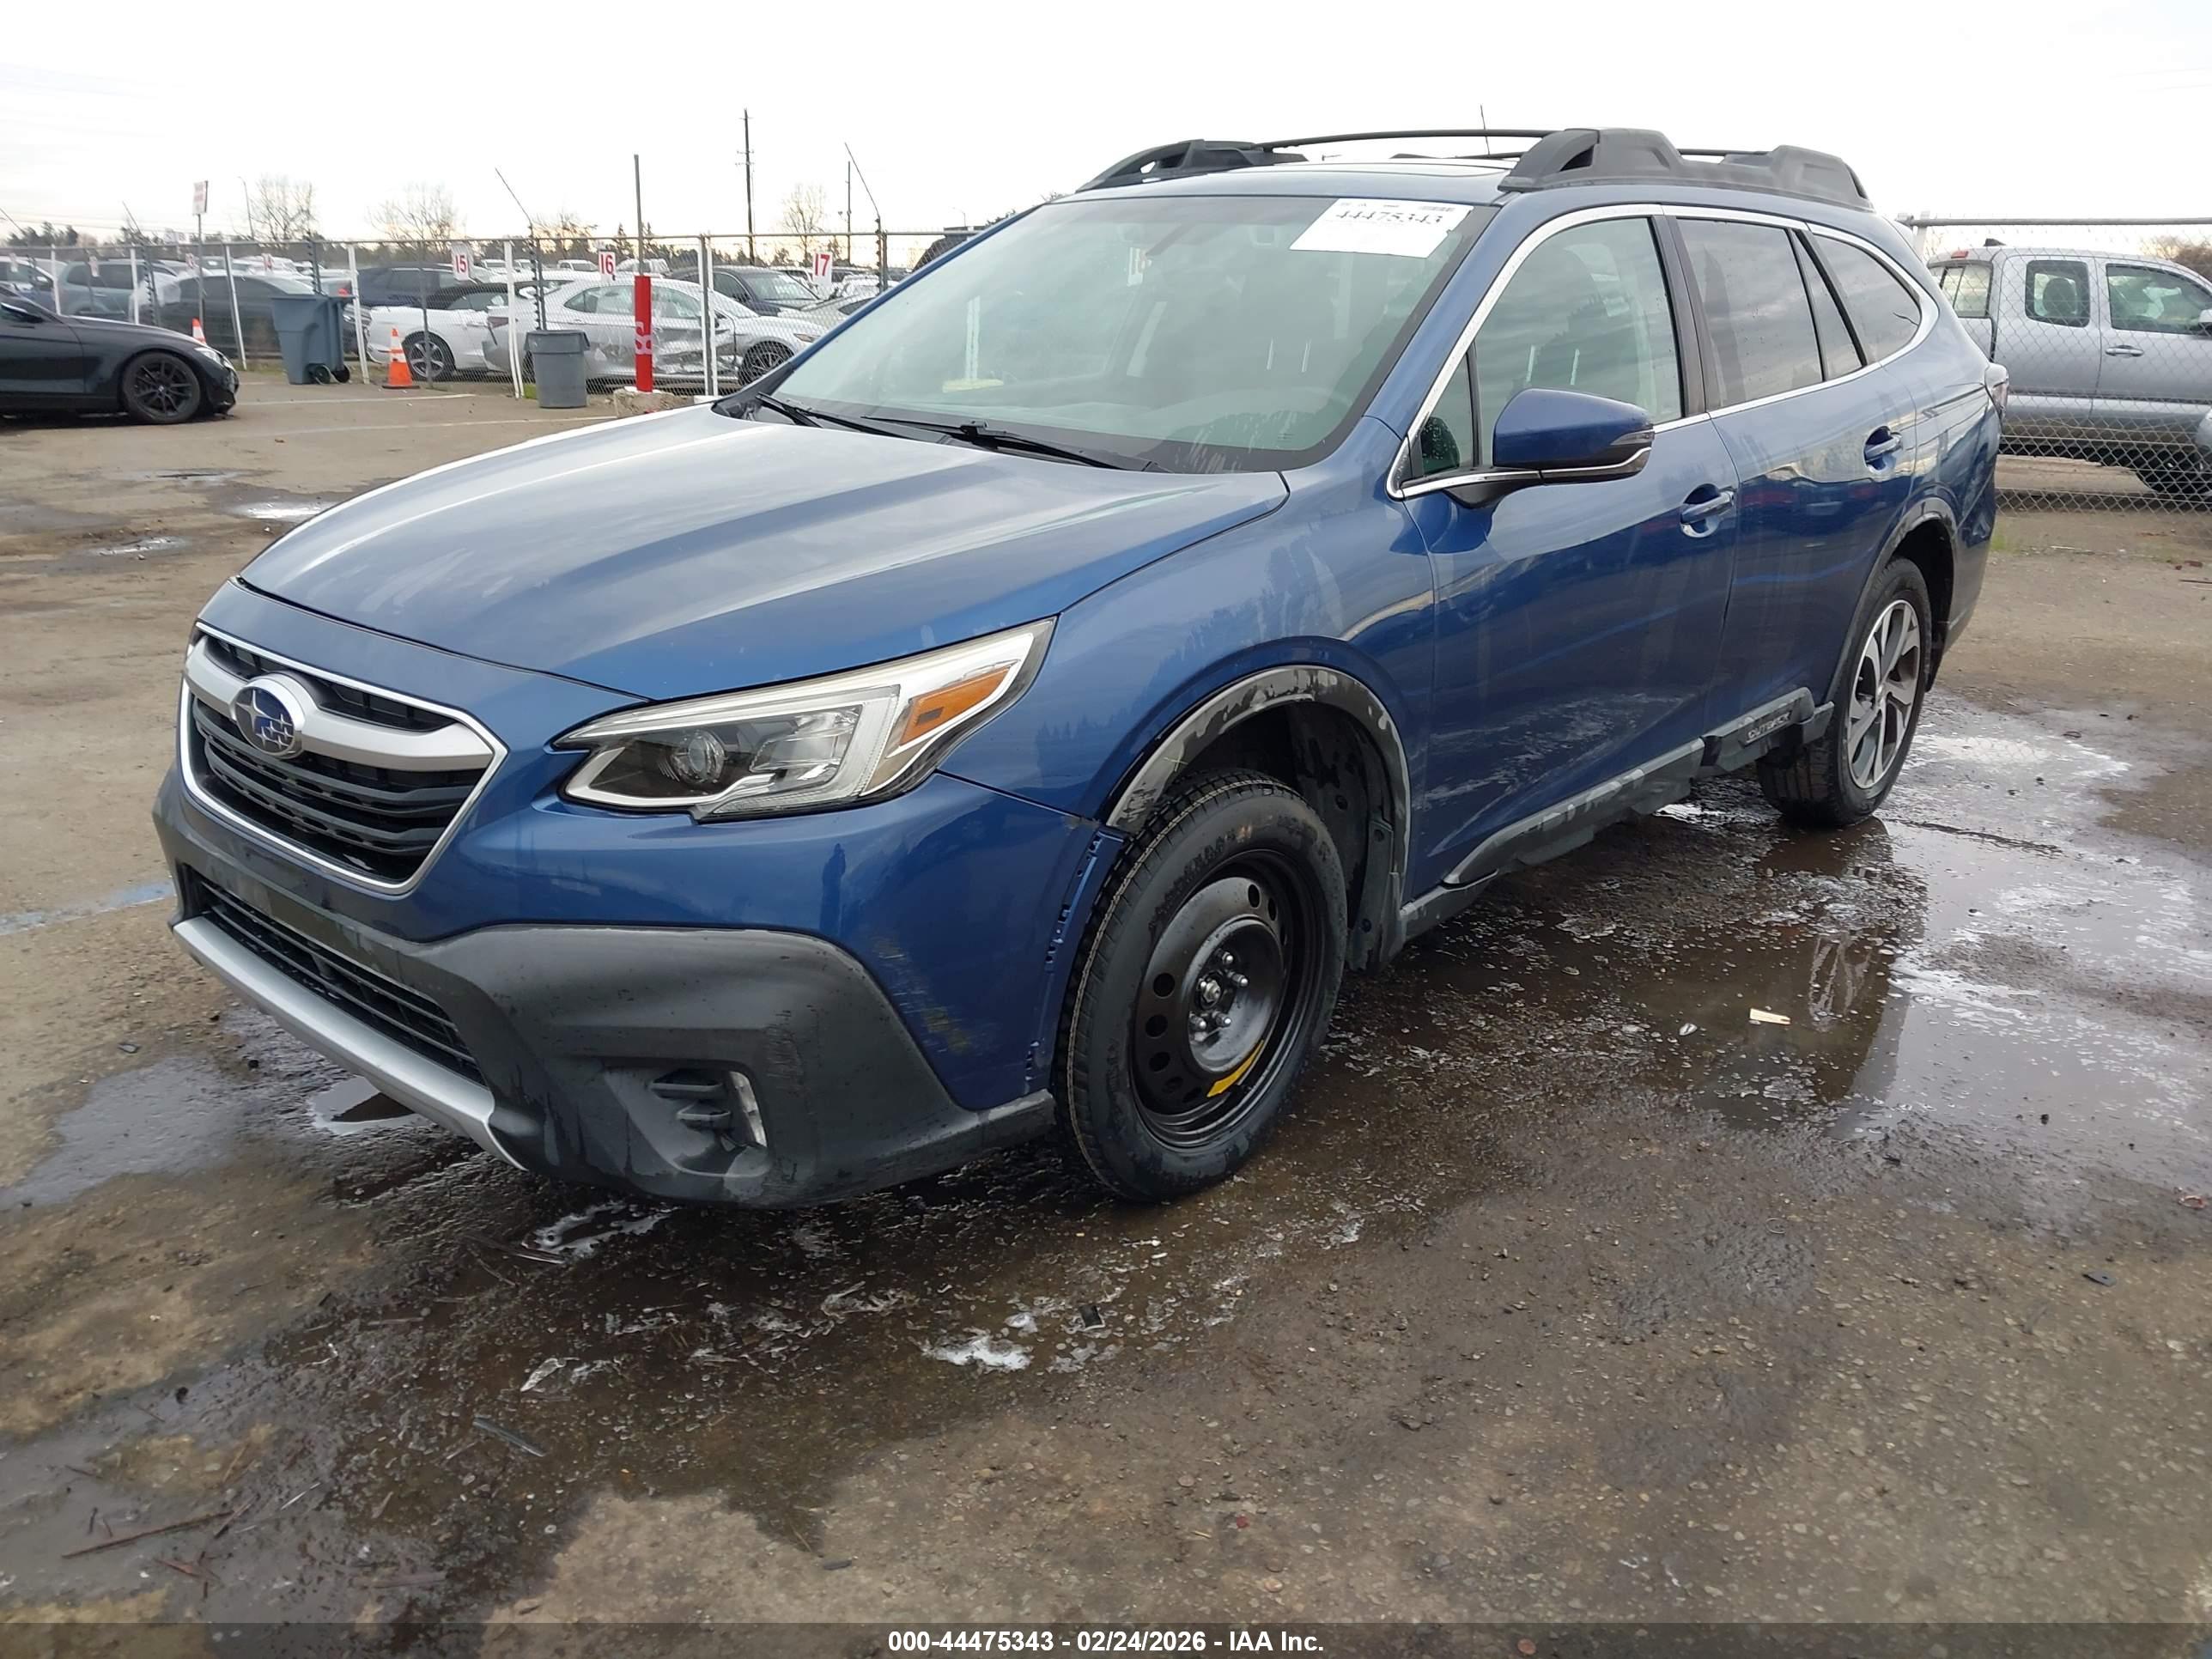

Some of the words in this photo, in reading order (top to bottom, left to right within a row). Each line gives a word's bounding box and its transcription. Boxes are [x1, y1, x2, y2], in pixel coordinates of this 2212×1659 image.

[455, 254, 466, 273] 15
[601, 254, 614, 274] 16
[815, 253, 830, 276] 17
